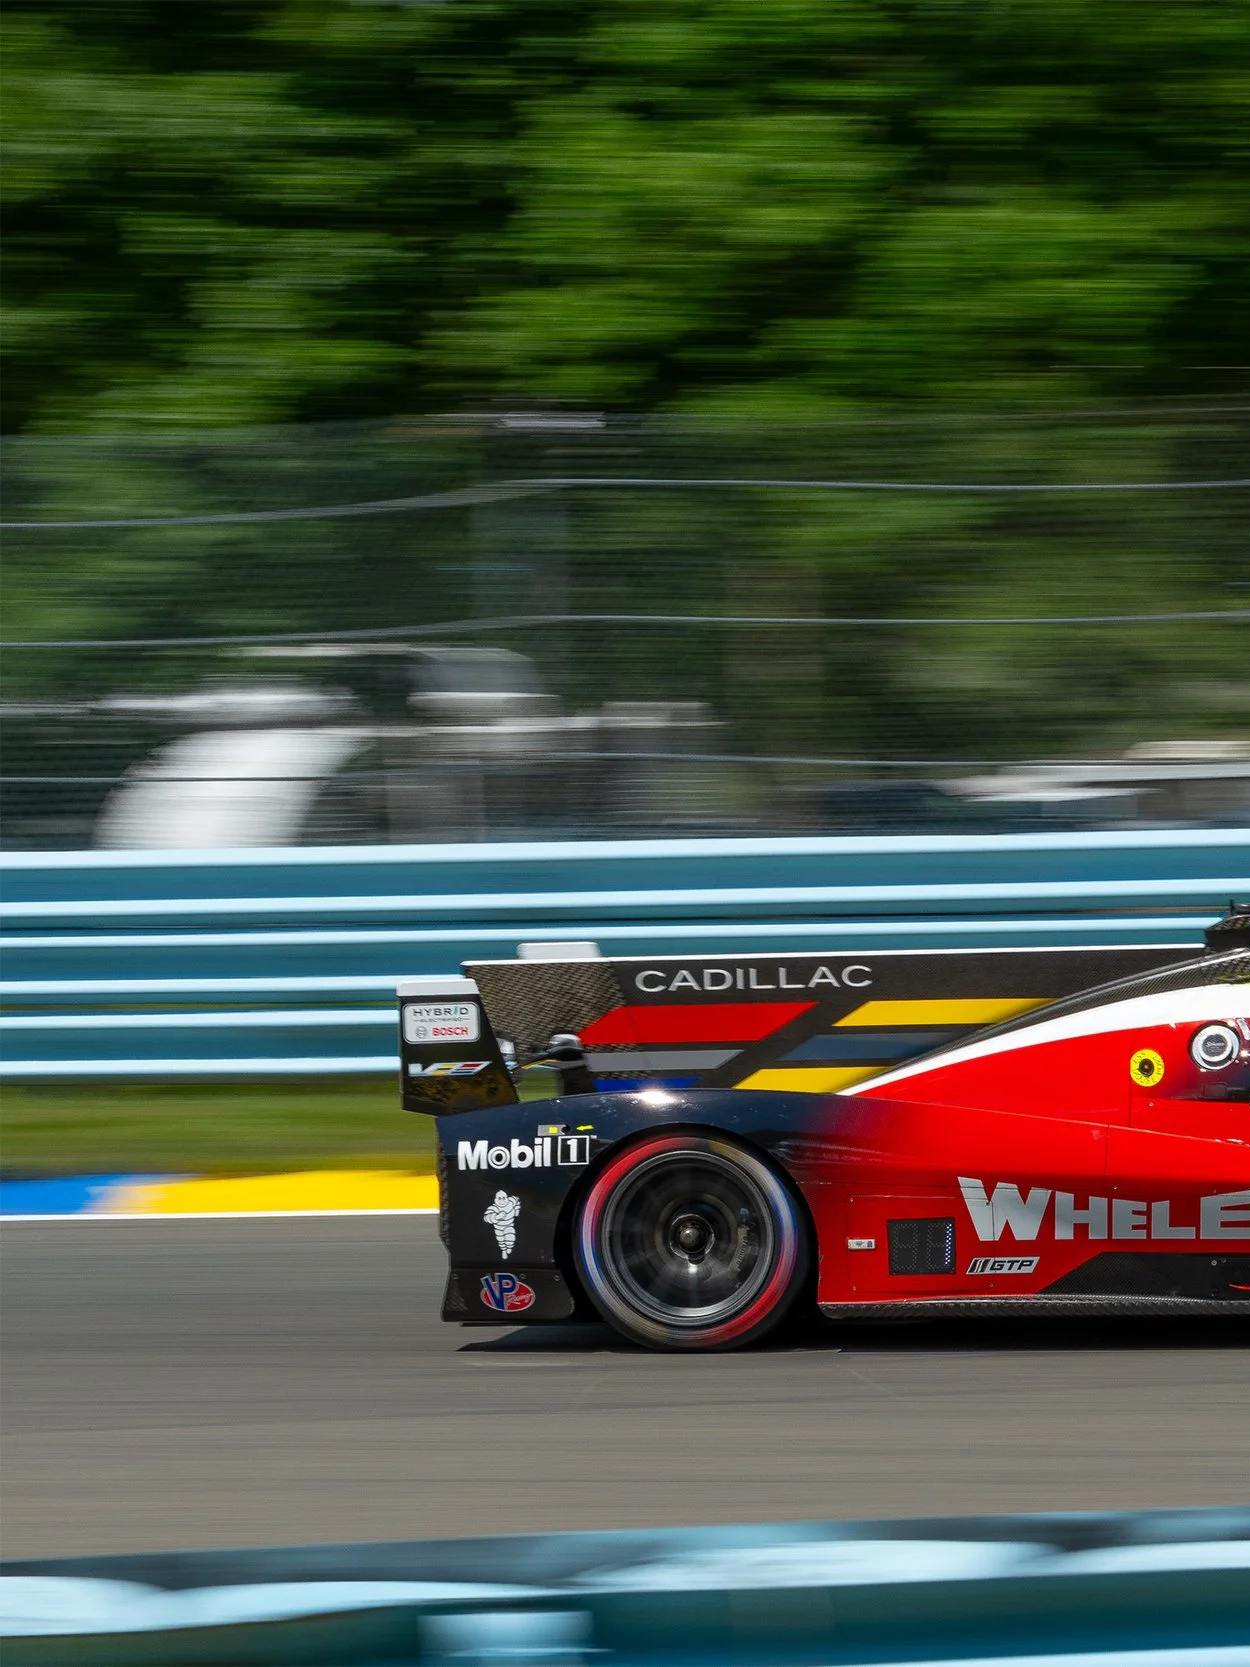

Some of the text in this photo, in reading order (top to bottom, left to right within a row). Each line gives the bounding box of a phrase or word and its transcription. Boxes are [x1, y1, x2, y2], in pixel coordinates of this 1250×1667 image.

[634, 965, 873, 992] CADILLAC
[412, 1007, 469, 1016] HYBRID
[431, 1026, 469, 1036] BOSCH
[457, 1137, 552, 1171] Mobil
[989, 1259, 1034, 1271] GTP
[480, 1272, 519, 1311] VP
